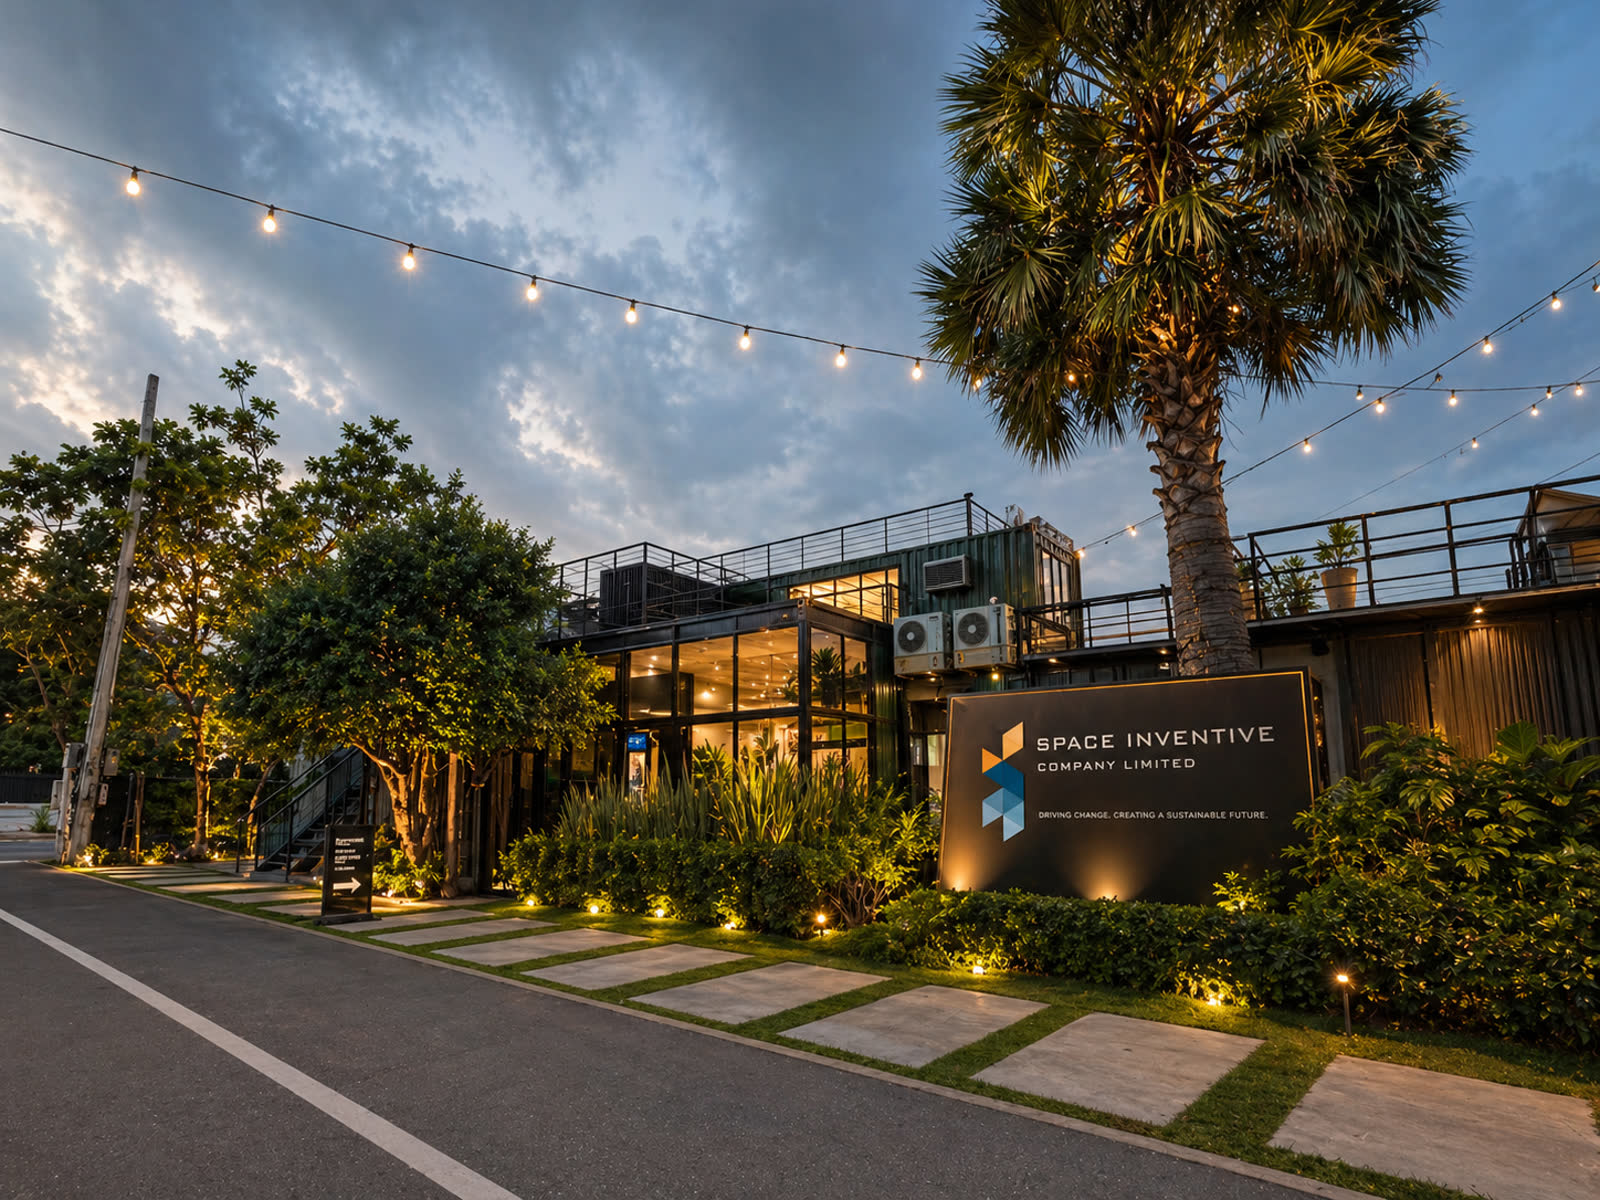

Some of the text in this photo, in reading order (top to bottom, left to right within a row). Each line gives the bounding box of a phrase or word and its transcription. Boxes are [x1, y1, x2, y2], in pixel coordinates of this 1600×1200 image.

[1036, 726, 1275, 752] SPACE INVENTIVE
[1037, 758, 1196, 772] COMPANY LIMITED
[1038, 811, 1269, 819] DRIVING CHANGE. CREATING A SUSTAINABLE FUTURE.
